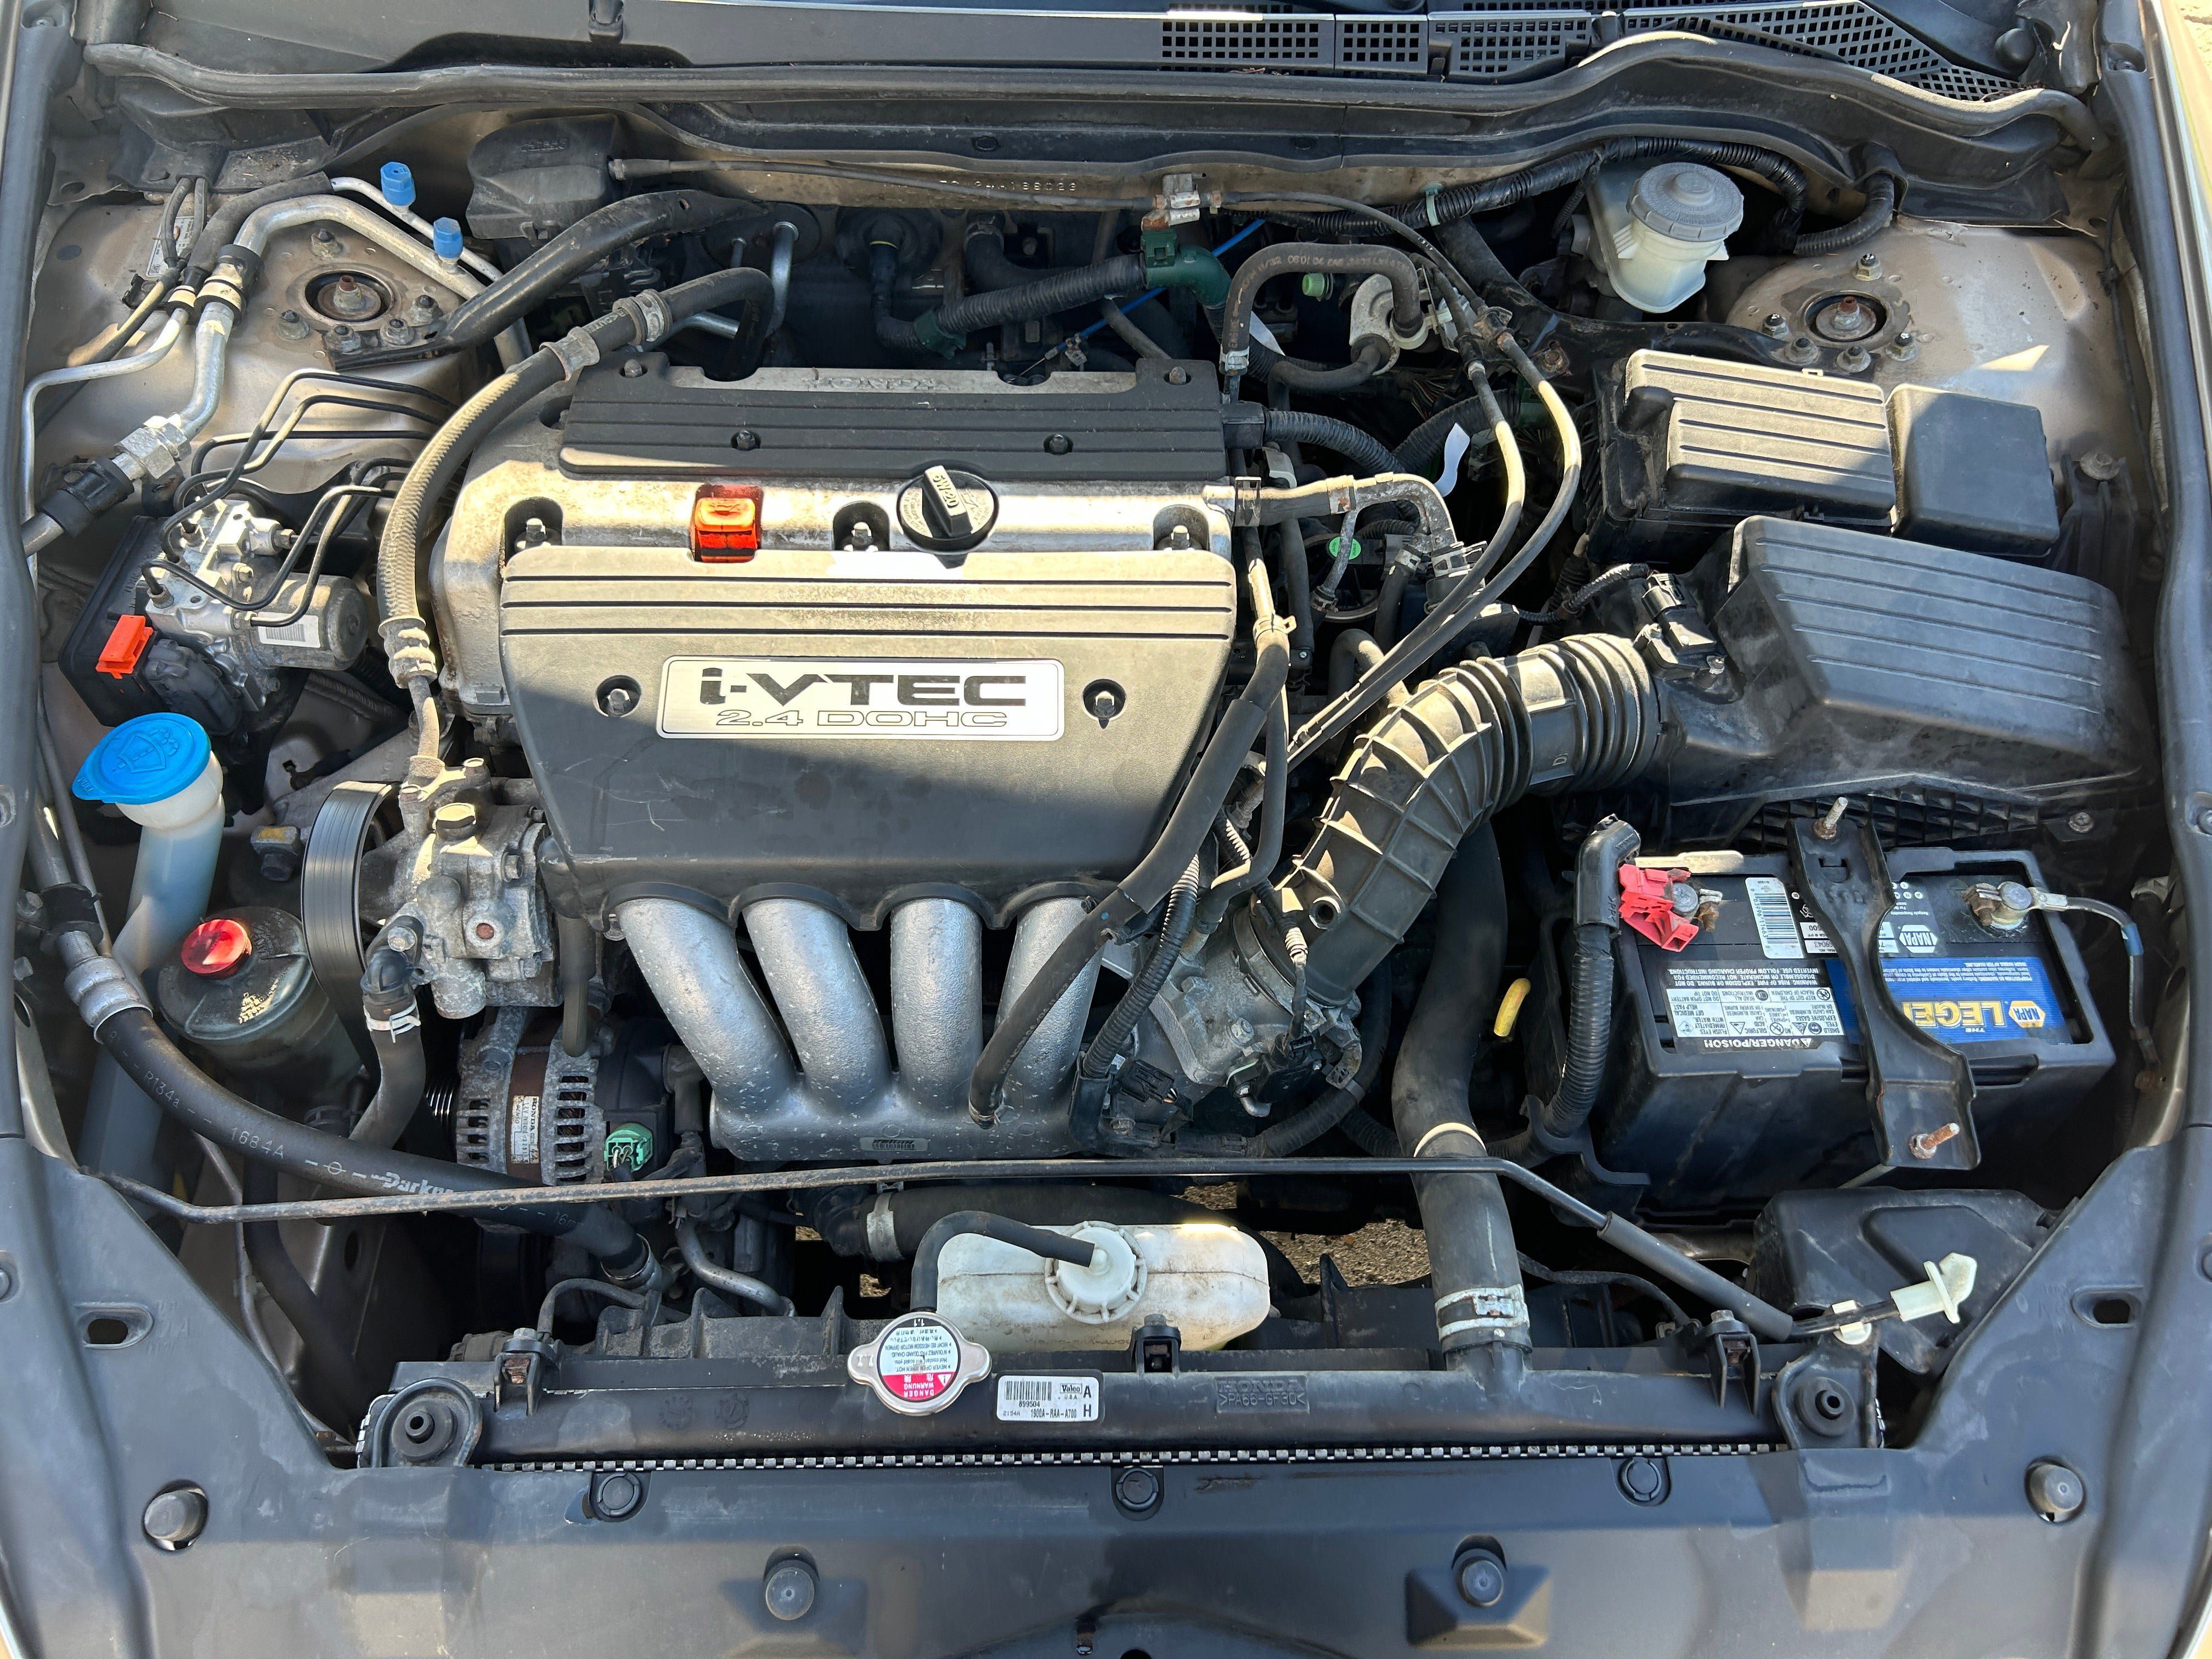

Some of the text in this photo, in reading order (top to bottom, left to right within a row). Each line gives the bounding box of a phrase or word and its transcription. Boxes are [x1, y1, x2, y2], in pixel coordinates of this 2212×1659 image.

[932, 475, 960, 509] 5W-20
[700, 667, 1026, 707] i-VTEC
[716, 710, 1007, 727] 2.4 DOHC
[1904, 932, 1932, 946] NAPA
[2013, 1008, 2040, 1020] NAPA
[1704, 1039, 1799, 1048] DANGER/POISON
[143, 1069, 181, 1107] R134a
[229, 1126, 285, 1159] 1684A
[913, 1318, 925, 1327] 1.1
[1062, 1384, 1080, 1392] Valeo
[1083, 1385, 1091, 1398] A
[1218, 1380, 1305, 1392] HONDA
[904, 1389, 934, 1397] DANGER
[1084, 1404, 1091, 1417] H
